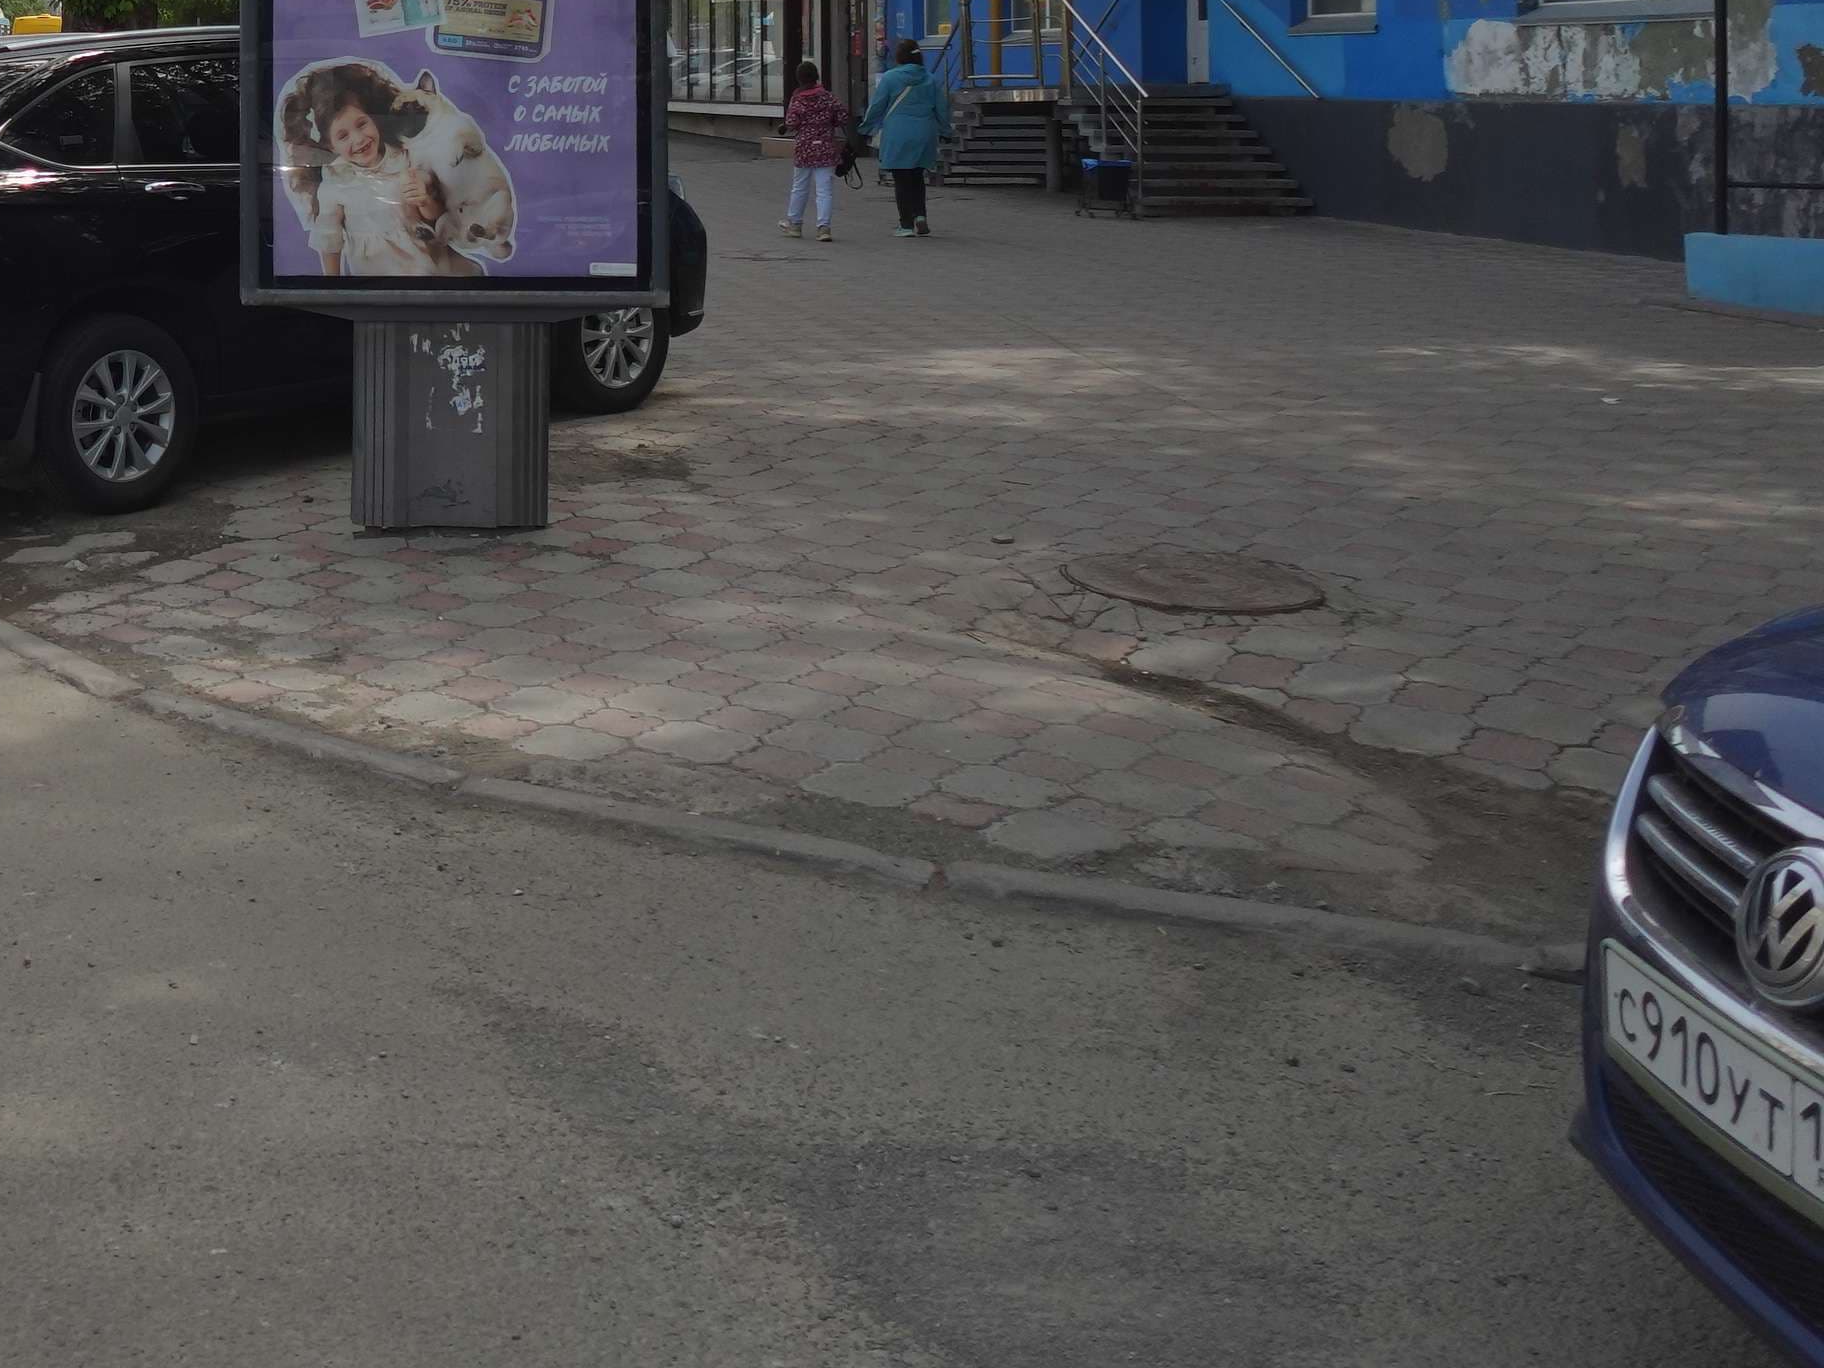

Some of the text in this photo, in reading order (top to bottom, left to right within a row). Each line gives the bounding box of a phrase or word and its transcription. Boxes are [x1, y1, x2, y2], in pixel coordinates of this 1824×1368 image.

[508, 72, 608, 98] С ЗАБОТОЙ
[513, 104, 603, 124] О САМЫХ
[504, 133, 611, 153] ЛЮБИМЫХ
[1619, 988, 1785, 1152] С910УТ
